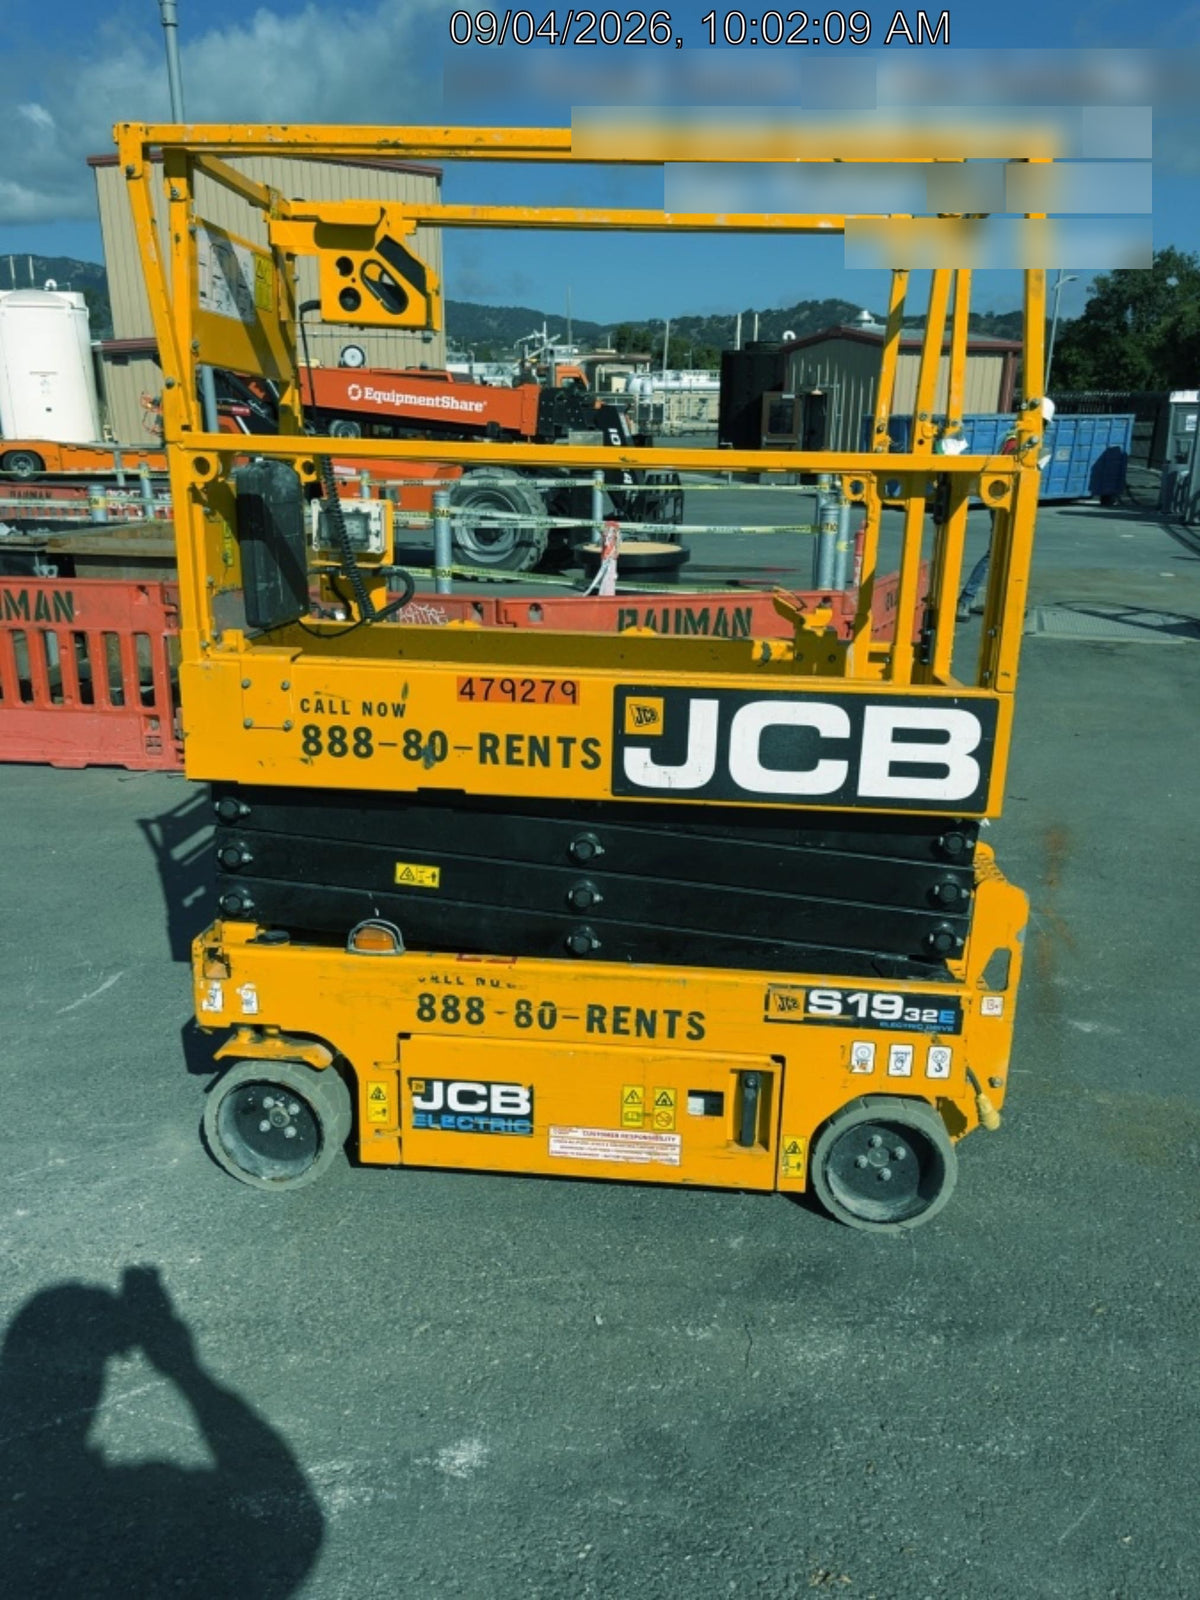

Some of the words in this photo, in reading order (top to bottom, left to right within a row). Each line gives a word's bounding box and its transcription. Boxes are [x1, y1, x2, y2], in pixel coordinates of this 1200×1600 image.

[364, 386, 484, 412] EquipmentShare
[0, 589, 74, 622] MAN
[459, 678, 577, 704] 479279
[300, 699, 350, 716] CALL
[362, 702, 406, 718] NOW
[302, 724, 602, 770] 888-80-RENTS
[623, 698, 981, 801] JCB
[417, 993, 706, 1041] 888-80-RENTS
[412, 1081, 531, 1115] JCB
[413, 1113, 531, 1134] ELECTRIC
